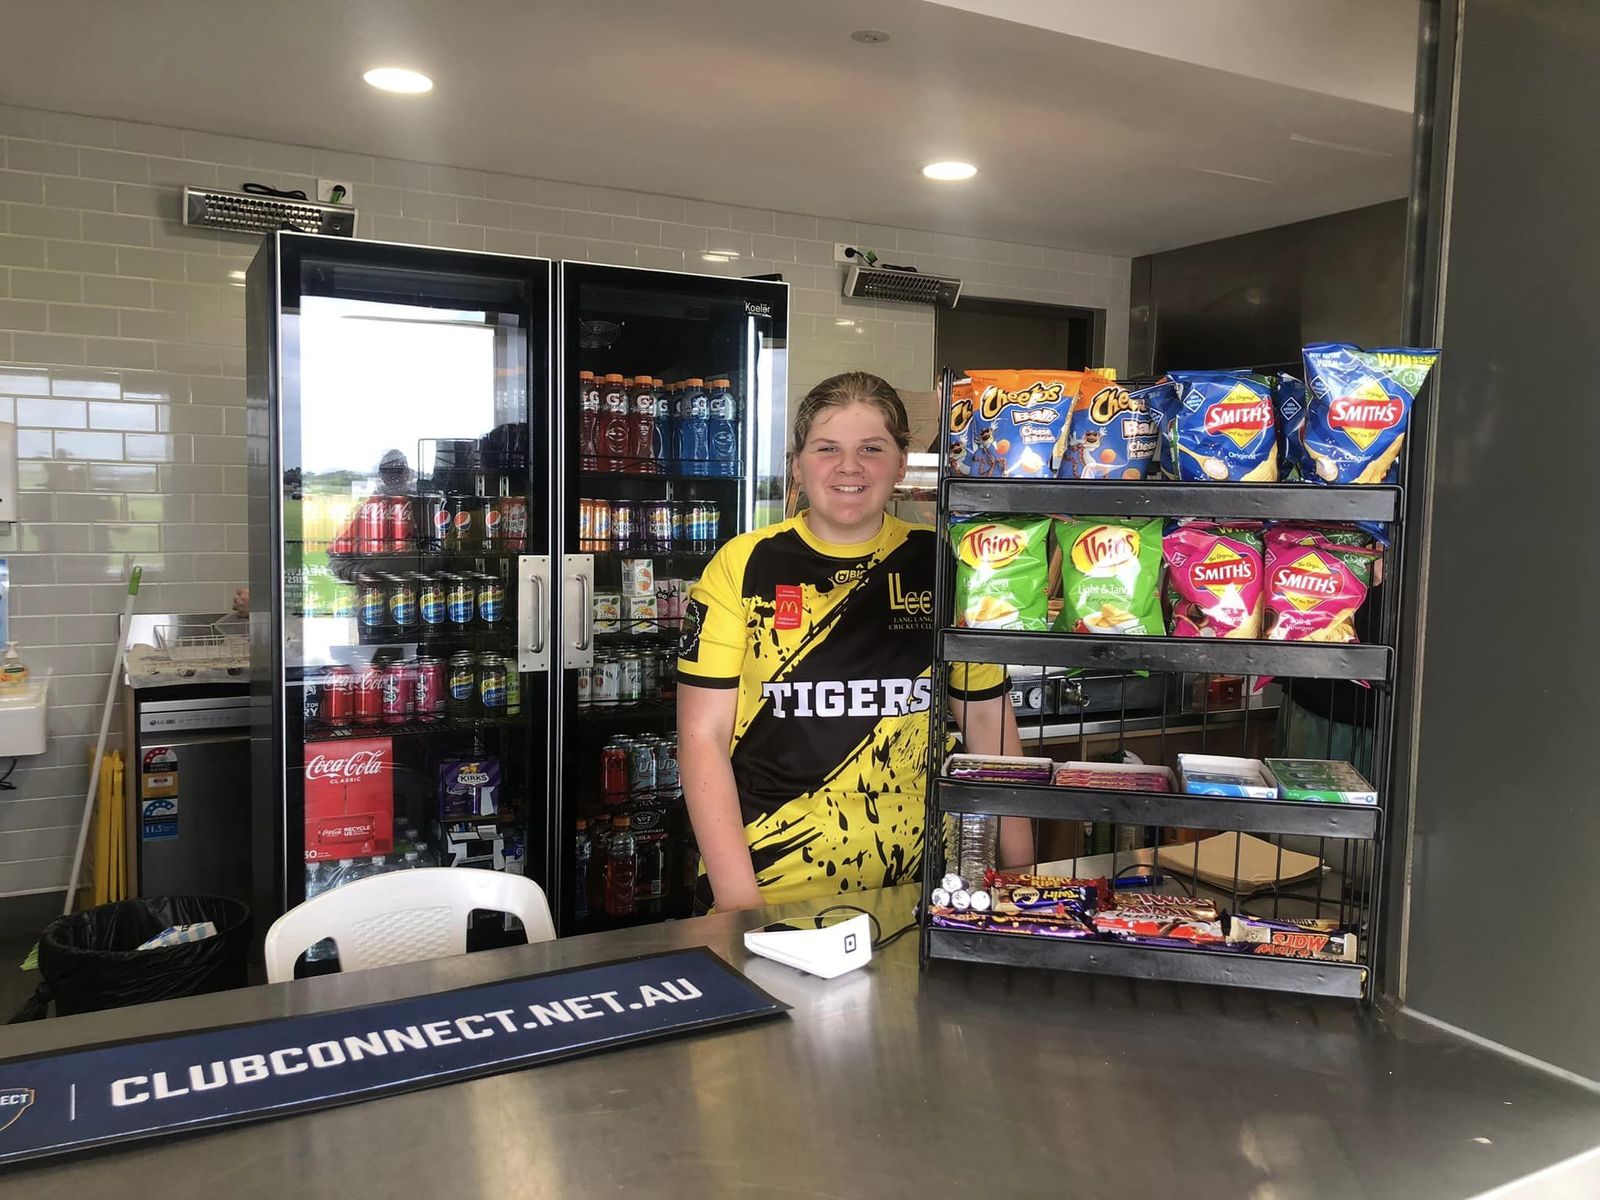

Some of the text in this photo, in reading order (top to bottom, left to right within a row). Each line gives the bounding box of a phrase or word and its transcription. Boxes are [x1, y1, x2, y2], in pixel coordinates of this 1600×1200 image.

[1377, 352, 1412, 368] WIN
[982, 382, 1062, 419] Cheetos
[1210, 402, 1271, 426] SMITH'S
[1332, 402, 1397, 421] SMITH'S
[1344, 451, 1372, 462] Origina
[963, 525, 1022, 558] Thins
[1194, 561, 1251, 581] SMITH'S
[1275, 569, 1338, 594] SMITH'S
[1078, 584, 1098, 595] Light
[1110, 584, 1129, 595] Tang
[762, 677, 933, 718] TIGERS
[305, 750, 386, 780] Coca-Cola
[329, 776, 361, 784] CLASSIC
[460, 774, 487, 782] KIRKS
[1042, 889, 1079, 901] Twirl
[1272, 933, 1329, 955] Mars
[109, 977, 704, 1108] CLUBCONNECT.NET.AU
